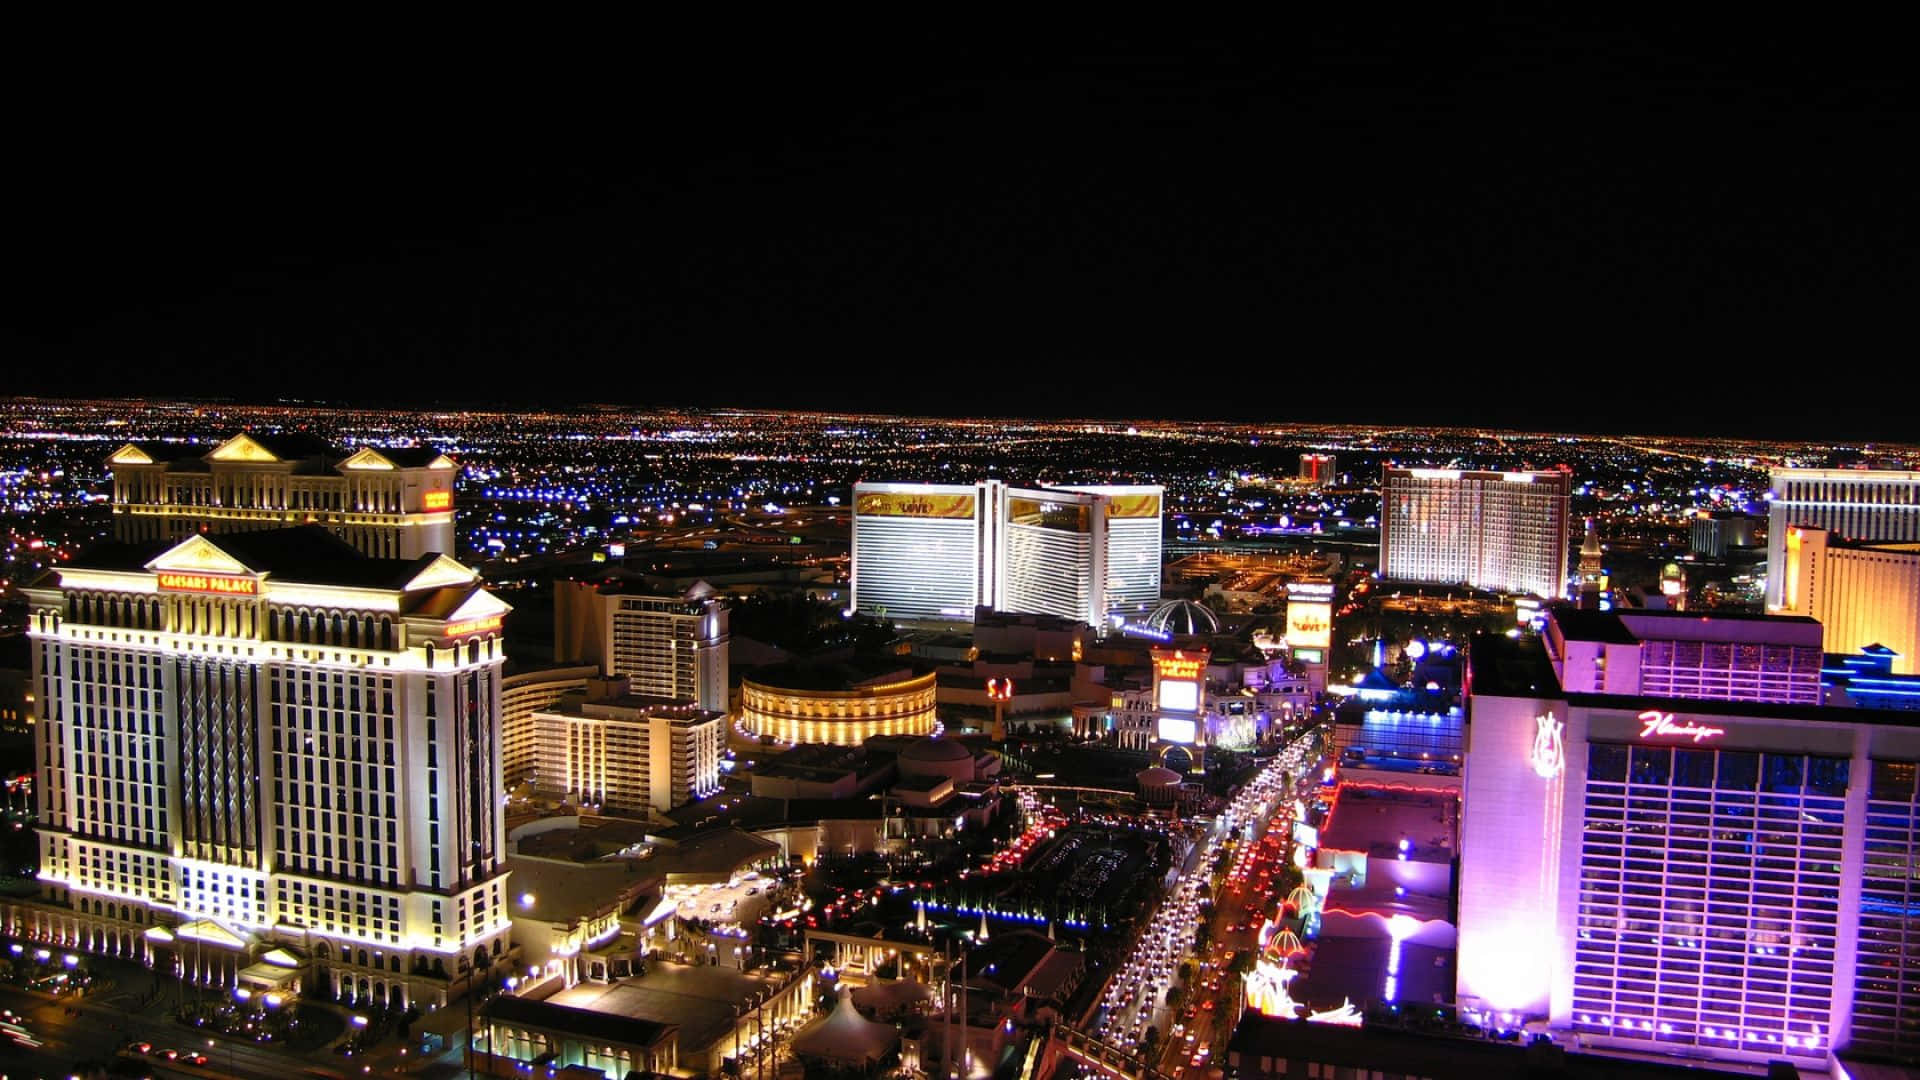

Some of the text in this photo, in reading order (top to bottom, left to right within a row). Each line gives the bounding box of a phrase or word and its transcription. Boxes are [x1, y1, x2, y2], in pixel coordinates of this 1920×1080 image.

[161, 575, 254, 593] CAESARS PALACE
[1297, 623, 1321, 632] LOVE
[1638, 711, 1724, 742] Flamingo
